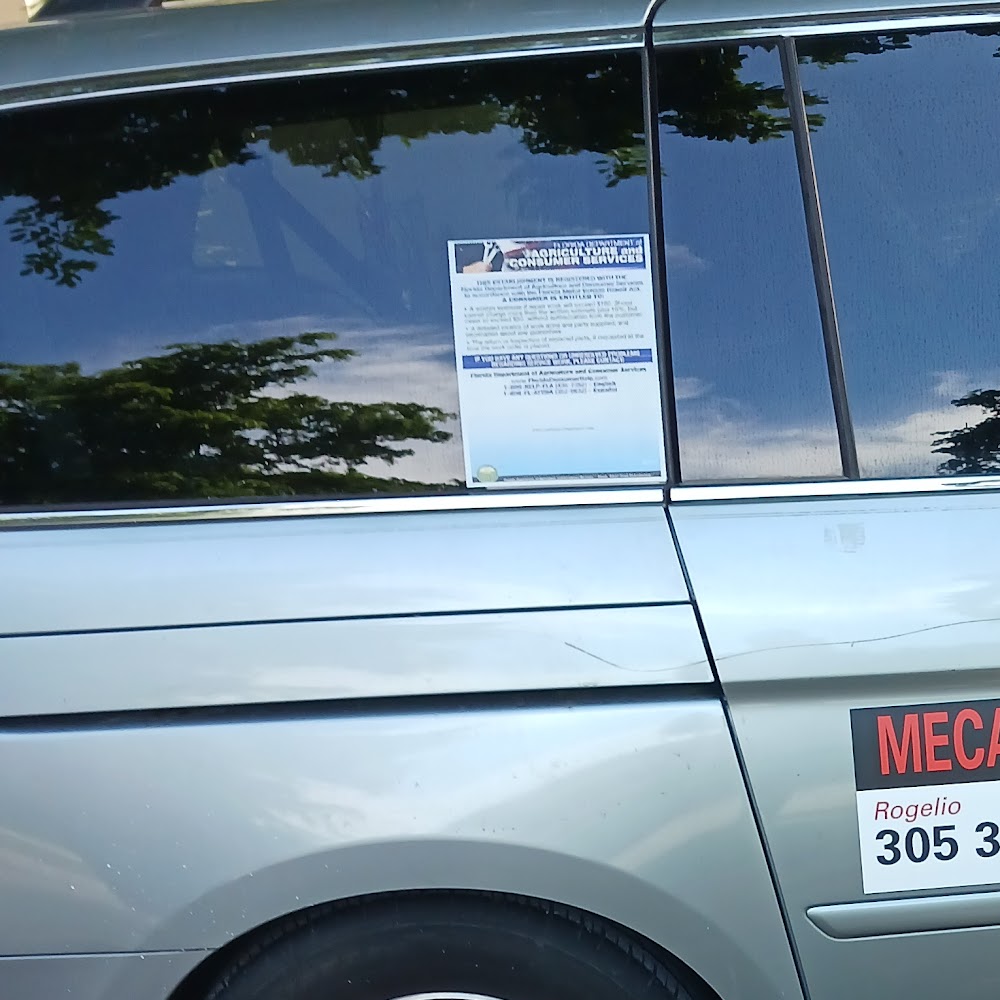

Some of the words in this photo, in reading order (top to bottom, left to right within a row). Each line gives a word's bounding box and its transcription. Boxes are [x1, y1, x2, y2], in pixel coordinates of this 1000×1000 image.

[509, 256, 580, 268] CONSUMER
[582, 254, 643, 266] SERVICES
[529, 246, 618, 258] AGRICULTURE
[620, 245, 643, 256] and
[874, 796, 962, 824] Rogelio
[875, 825, 960, 866] 305
